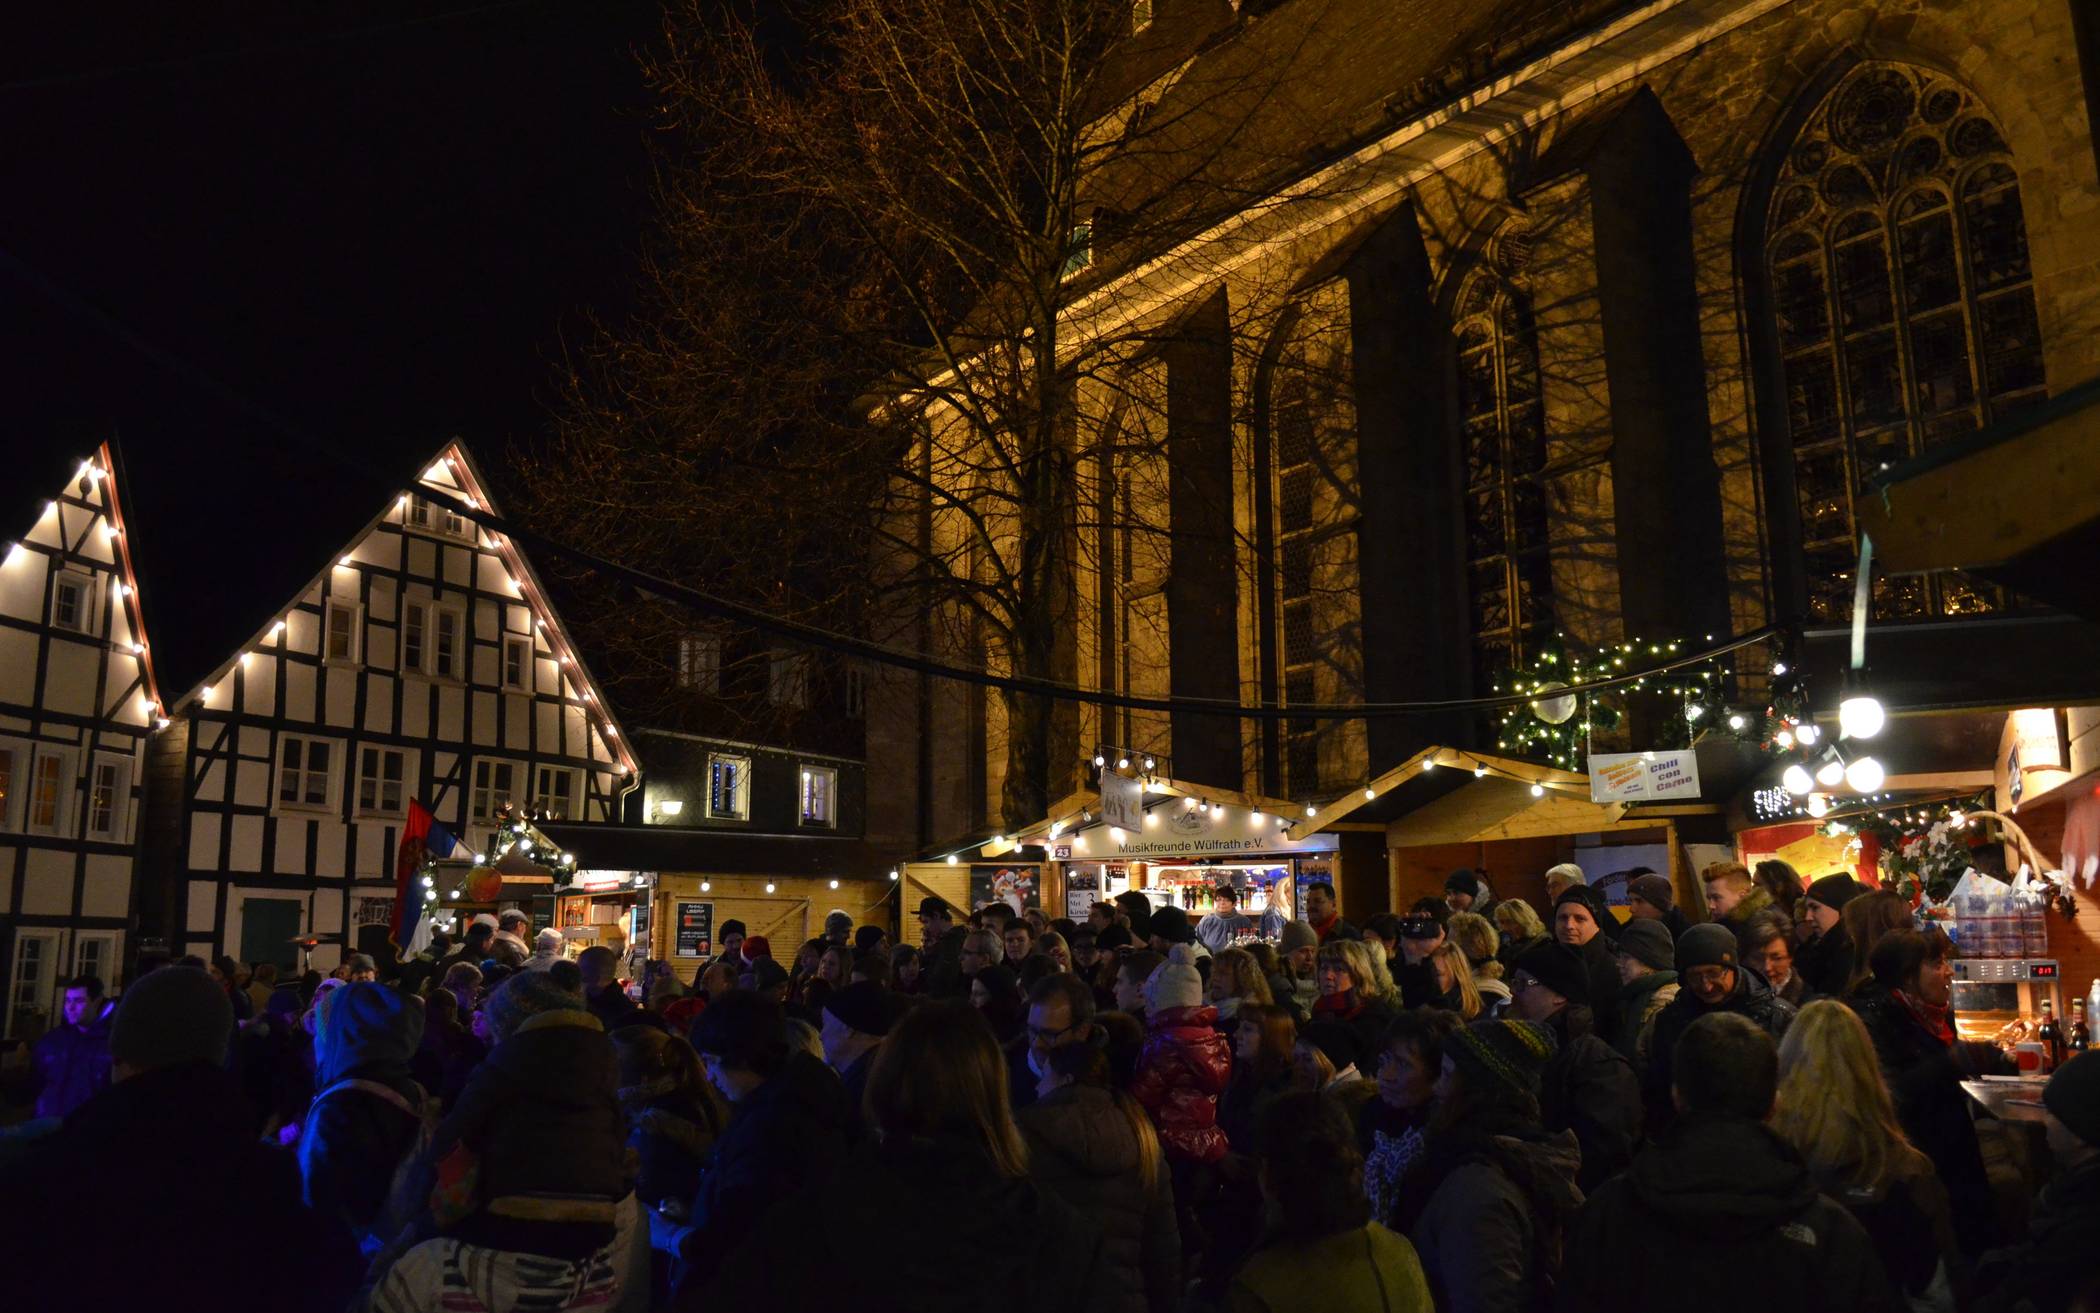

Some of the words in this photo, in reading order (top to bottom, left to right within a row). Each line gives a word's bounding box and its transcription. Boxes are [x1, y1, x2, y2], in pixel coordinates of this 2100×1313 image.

[1650, 759, 1678, 773] Chili
[1658, 769, 1681, 781] con
[1118, 840, 1192, 854] Musikfreunde
[1194, 838, 1241, 851] Wülfrath
[1244, 837, 1264, 849] e.V.
[1056, 848, 1069, 857] 23
